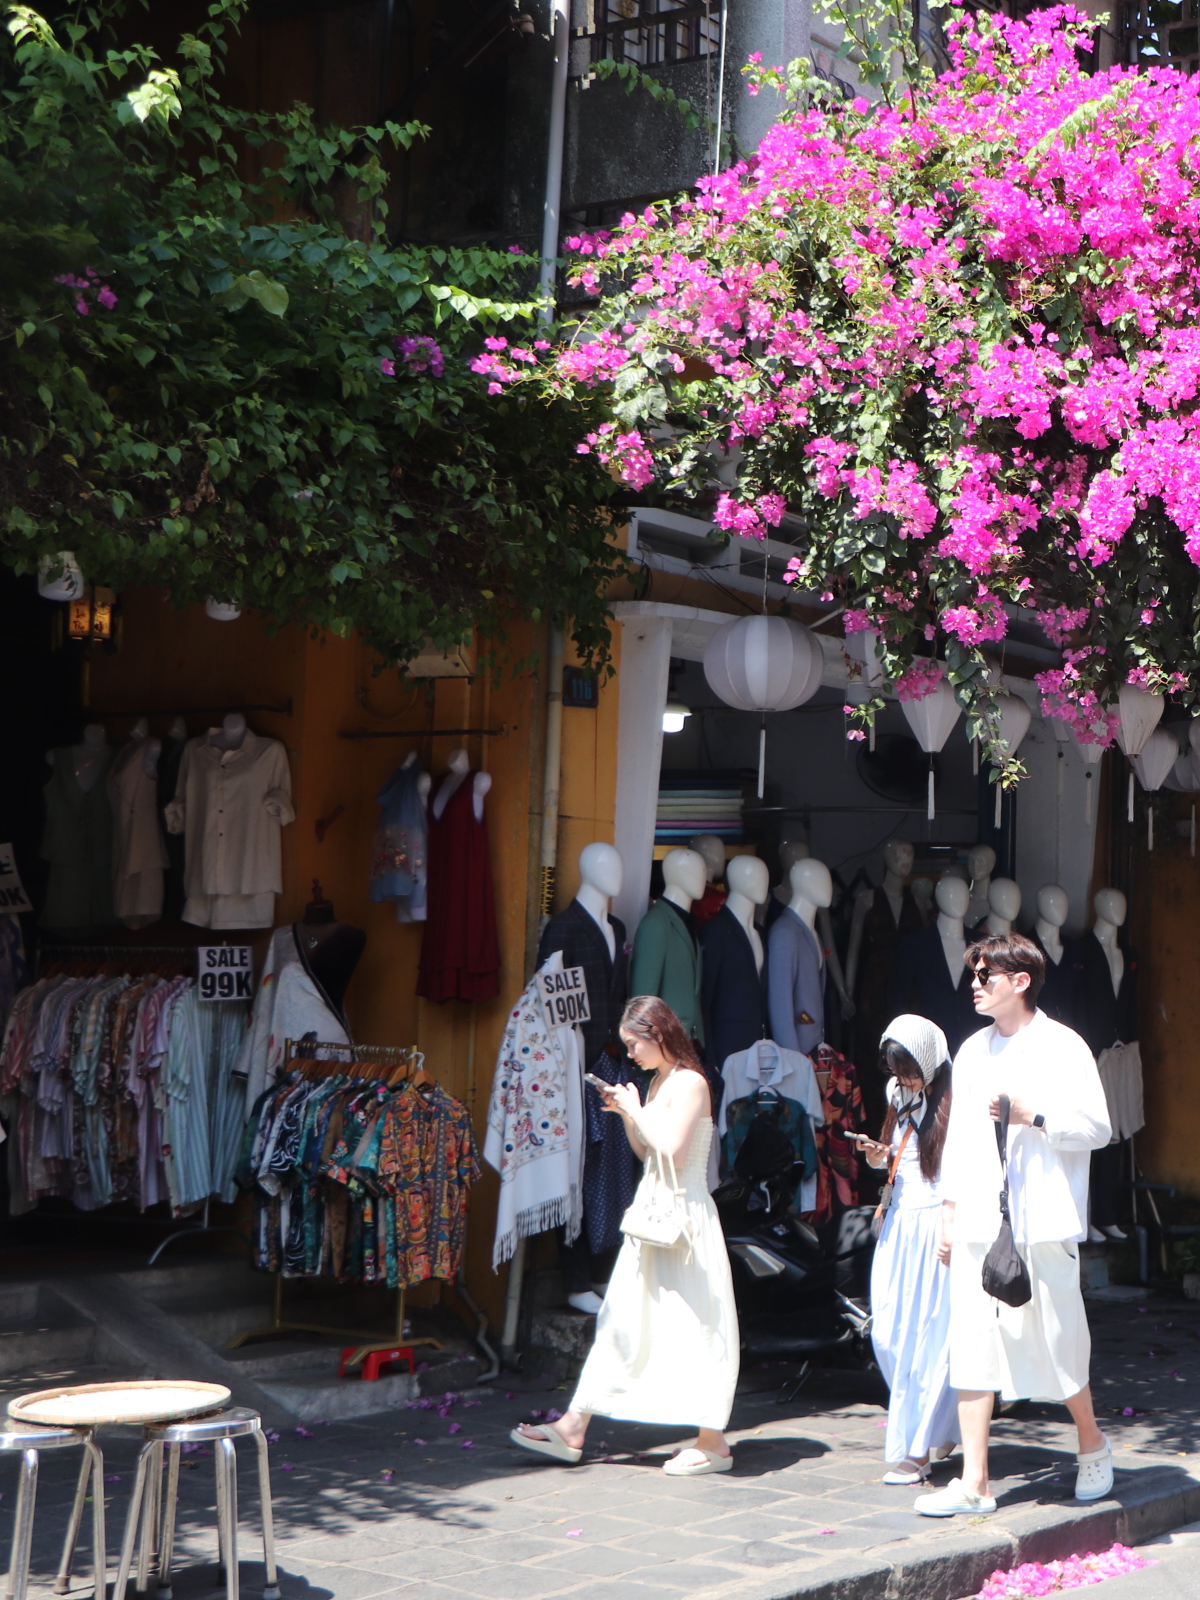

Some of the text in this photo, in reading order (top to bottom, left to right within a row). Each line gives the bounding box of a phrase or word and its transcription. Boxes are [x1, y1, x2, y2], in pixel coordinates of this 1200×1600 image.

[572, 678, 592, 700] 116
[206, 948, 248, 968] SALE
[201, 971, 252, 998] 99K
[544, 970, 581, 994] SALE
[545, 992, 588, 1025] 190K
